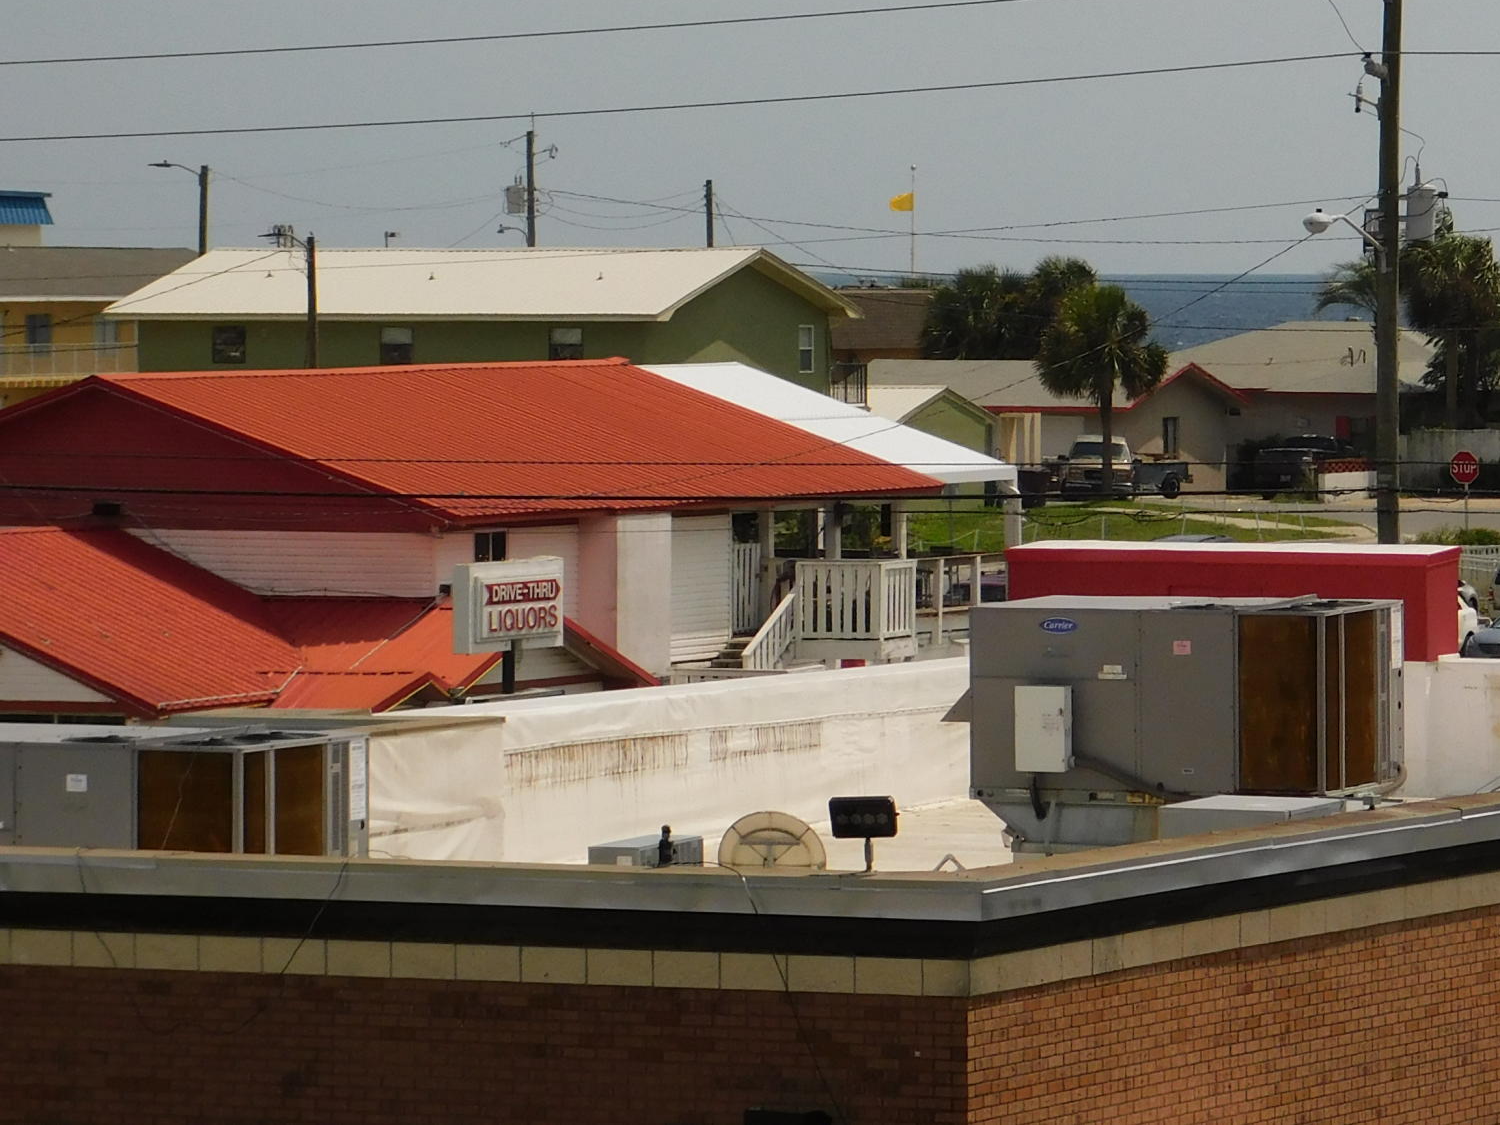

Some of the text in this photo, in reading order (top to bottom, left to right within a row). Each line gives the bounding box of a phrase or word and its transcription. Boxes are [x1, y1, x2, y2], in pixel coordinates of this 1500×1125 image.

[1452, 461, 1477, 474] STOP
[492, 581, 556, 602] DRIVE-THRU
[489, 604, 558, 632] LIQUORS
[1043, 620, 1074, 630] Carrier
